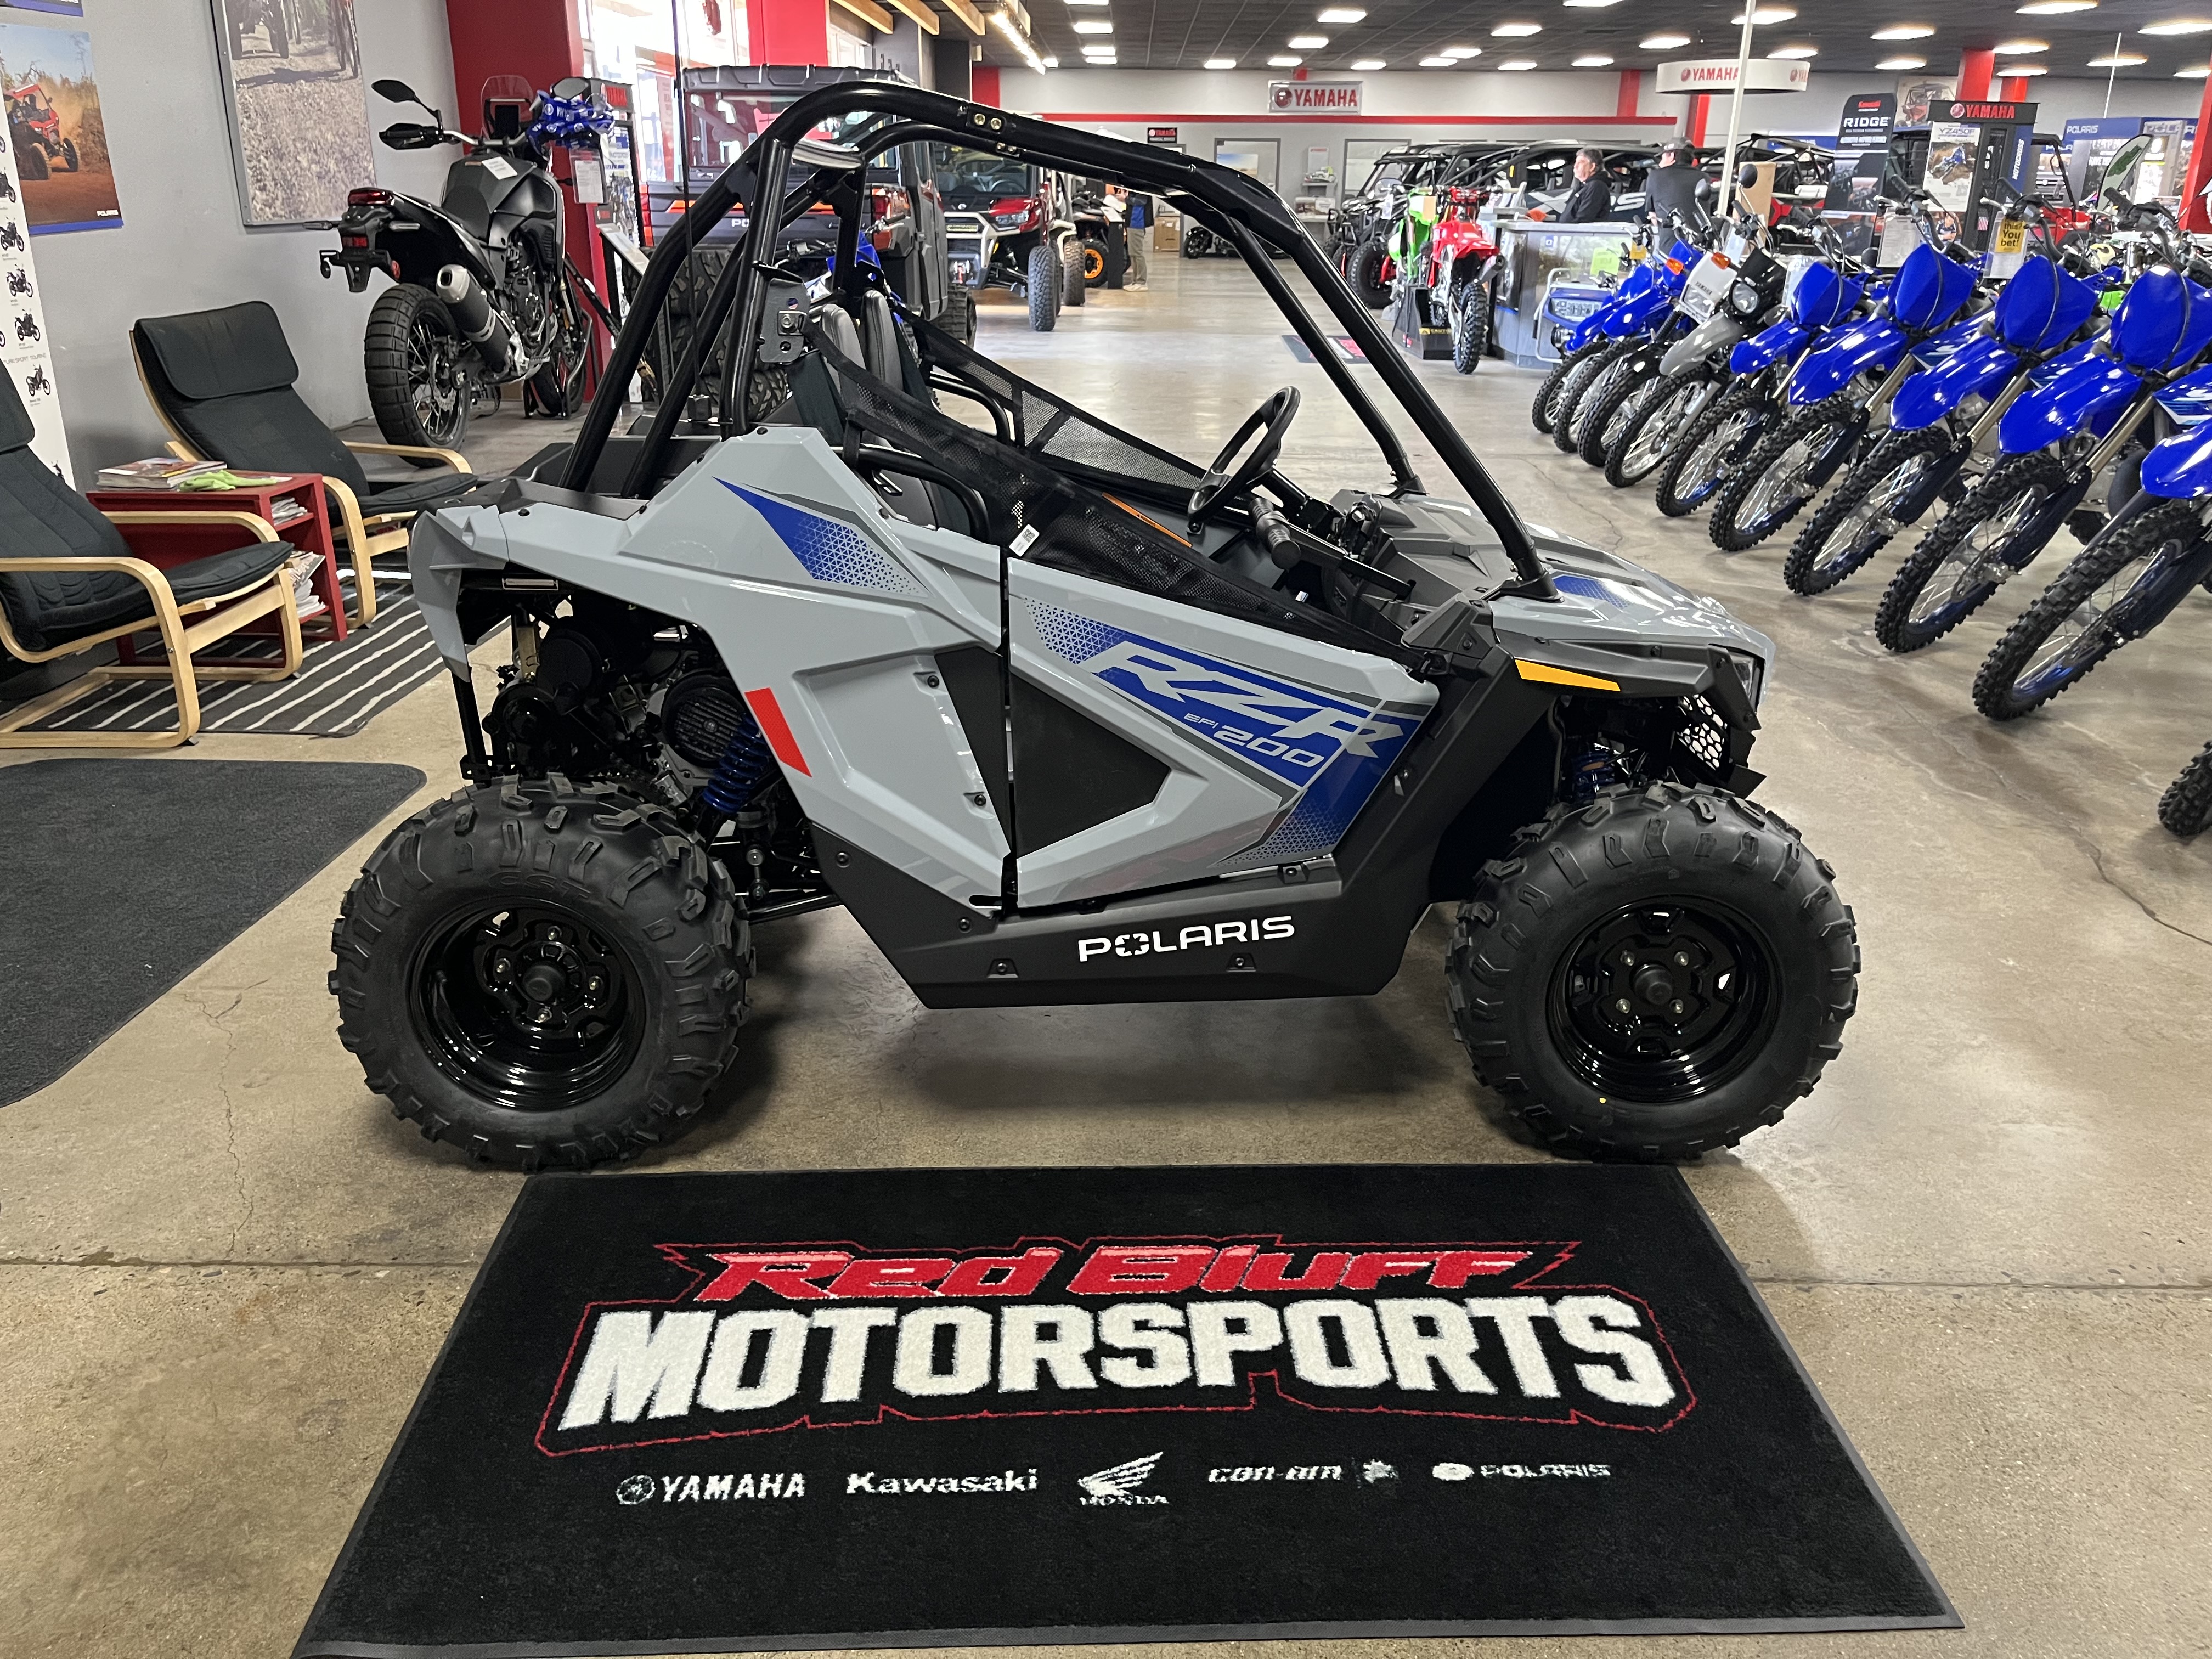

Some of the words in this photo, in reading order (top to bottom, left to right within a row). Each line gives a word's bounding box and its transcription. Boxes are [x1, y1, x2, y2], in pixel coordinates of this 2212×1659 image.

[1294, 89, 1358, 106] YAMAHA
[1843, 116, 1889, 127] RIDGE
[1966, 104, 2016, 119] YAMAHA
[2066, 125, 2098, 134] POLARIS
[2012, 138, 2024, 180] MOTOCROSS
[2000, 238, 2019, 247] bet!
[2002, 229, 2021, 239] You
[1077, 640, 1404, 758] RZR
[1183, 713, 1220, 729] EFI
[1213, 725, 1325, 768] 200
[1078, 915, 1295, 962] POLARIS
[557, 1295, 1676, 1431] MOTORSPORTS
[846, 1468, 1037, 1494] Kawasaki
[1480, 1464, 1611, 1479] POLARIS
[661, 1472, 805, 1503] YAMAHA
